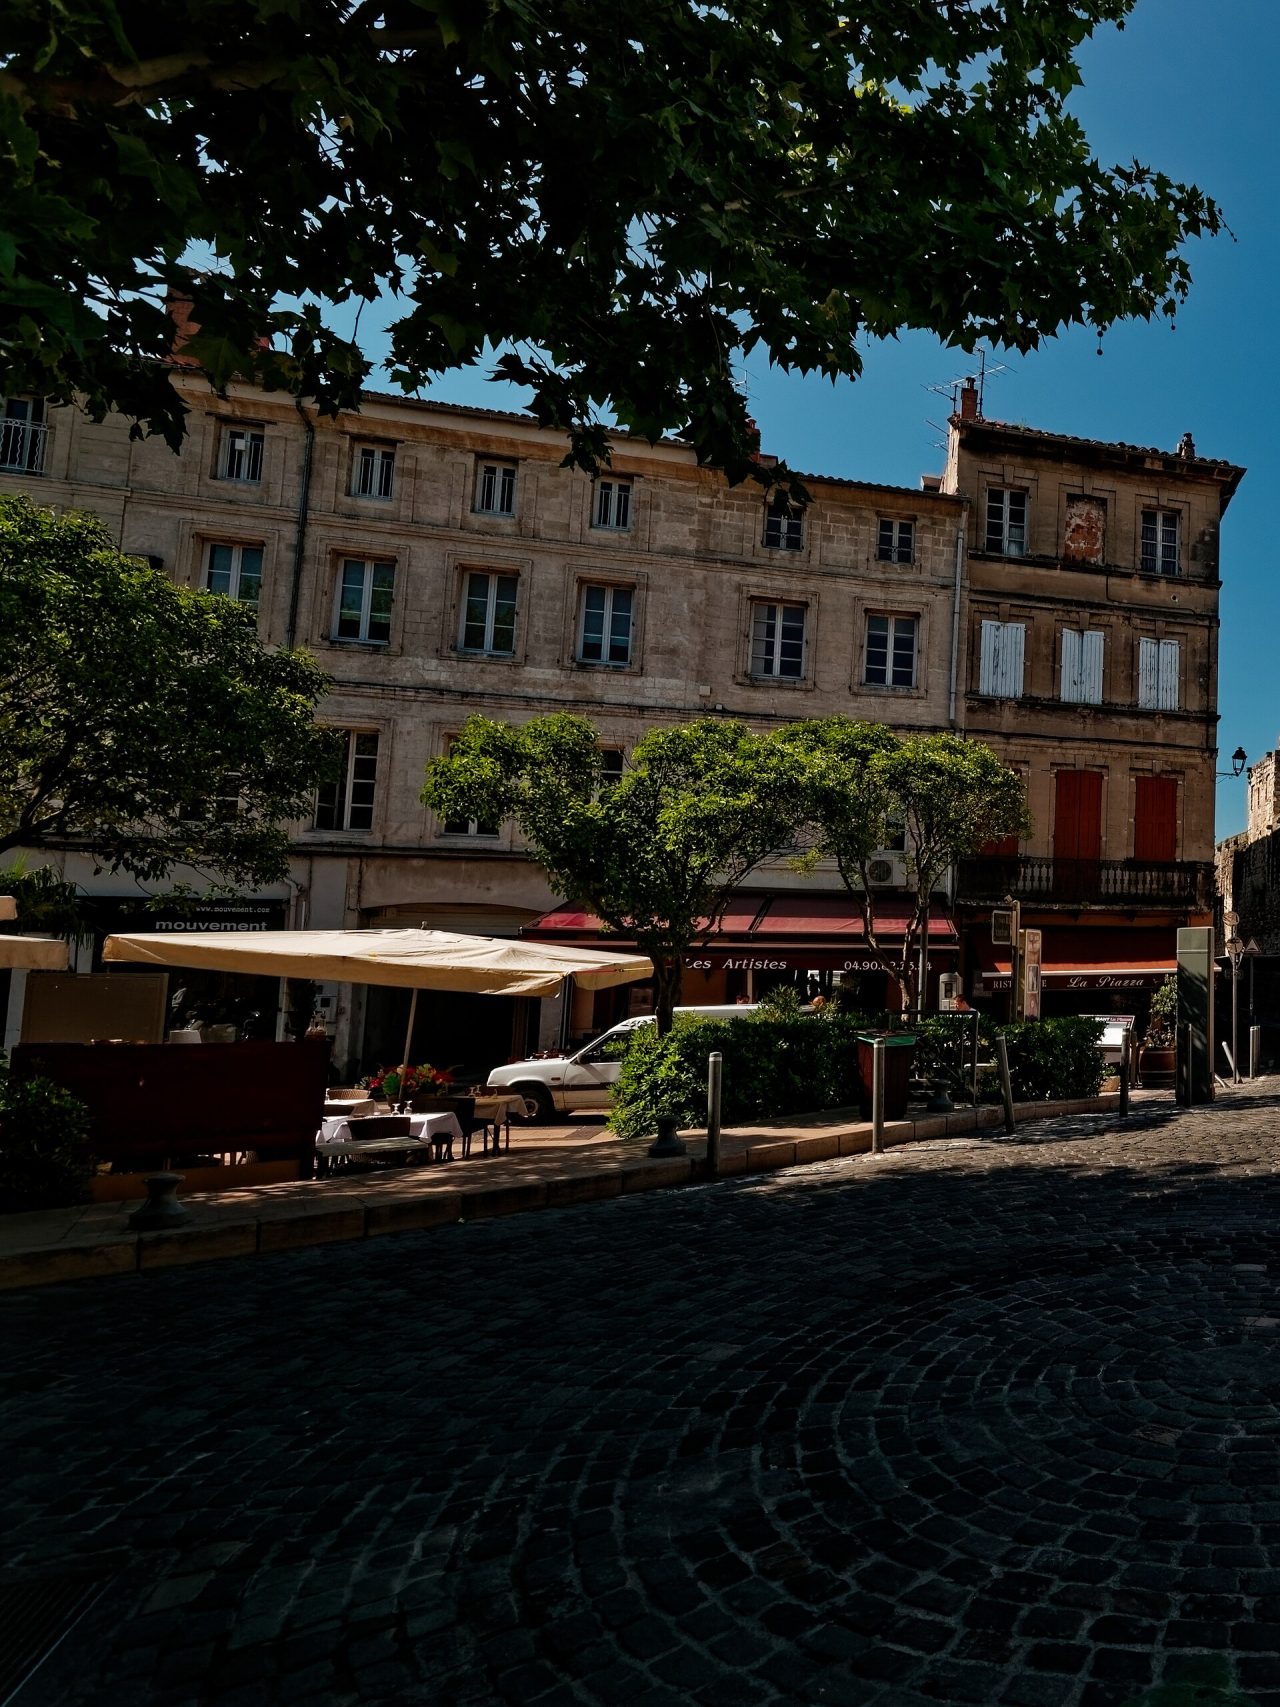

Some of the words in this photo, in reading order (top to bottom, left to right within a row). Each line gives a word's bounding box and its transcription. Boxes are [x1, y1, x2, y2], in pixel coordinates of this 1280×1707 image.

[155, 920, 269, 932] mouvement
[722, 958, 787, 970] Artistes
[1066, 975, 1088, 988] La
[1095, 975, 1145, 988] Piazza
